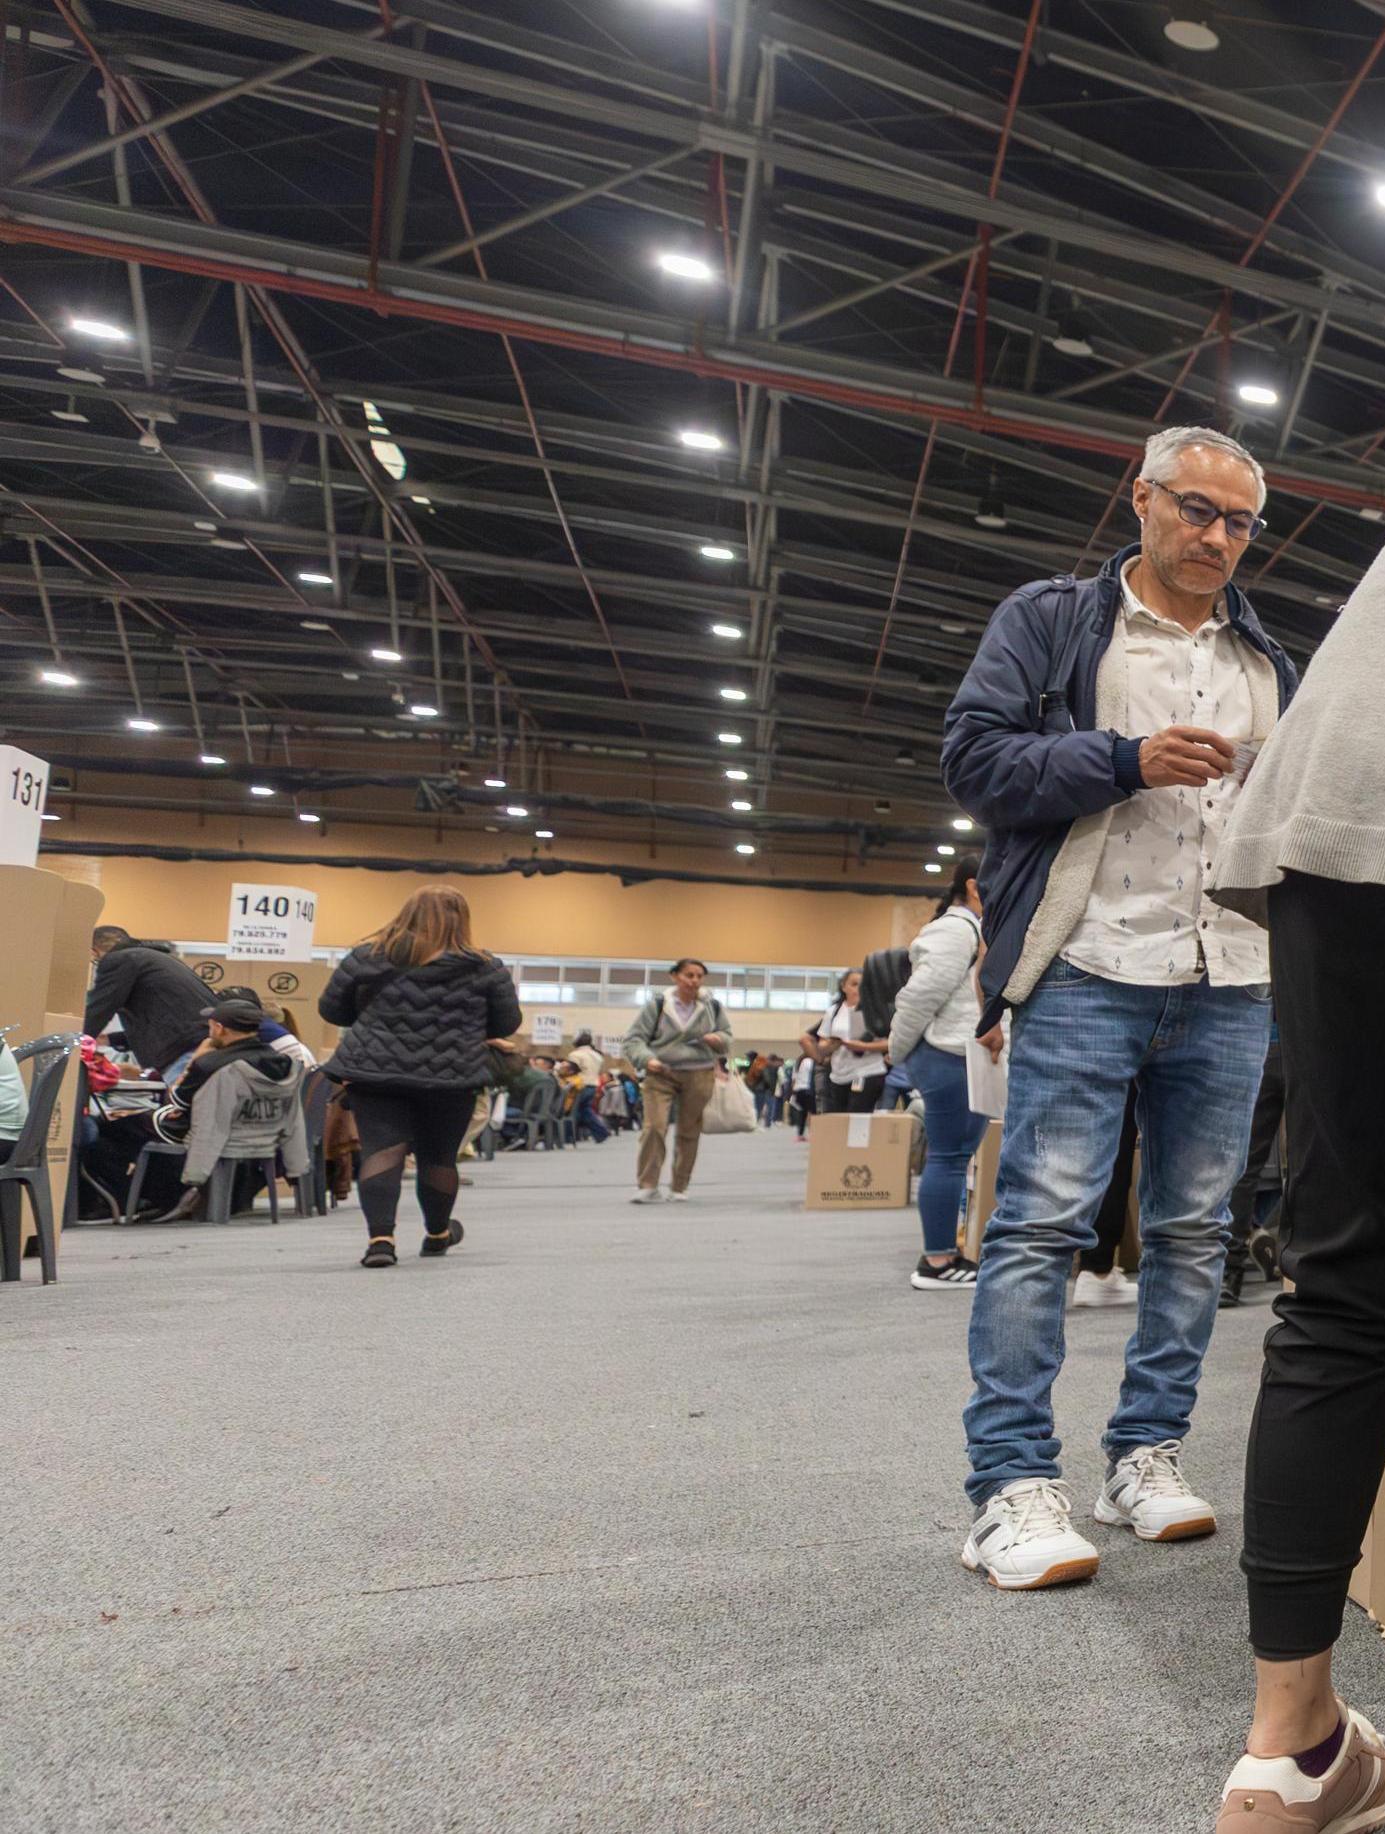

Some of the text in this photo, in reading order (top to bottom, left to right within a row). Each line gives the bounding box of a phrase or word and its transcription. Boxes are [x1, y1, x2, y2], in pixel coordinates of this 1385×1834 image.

[12, 767, 43, 811] 131
[236, 894, 290, 918] 140
[296, 899, 314, 923] 140
